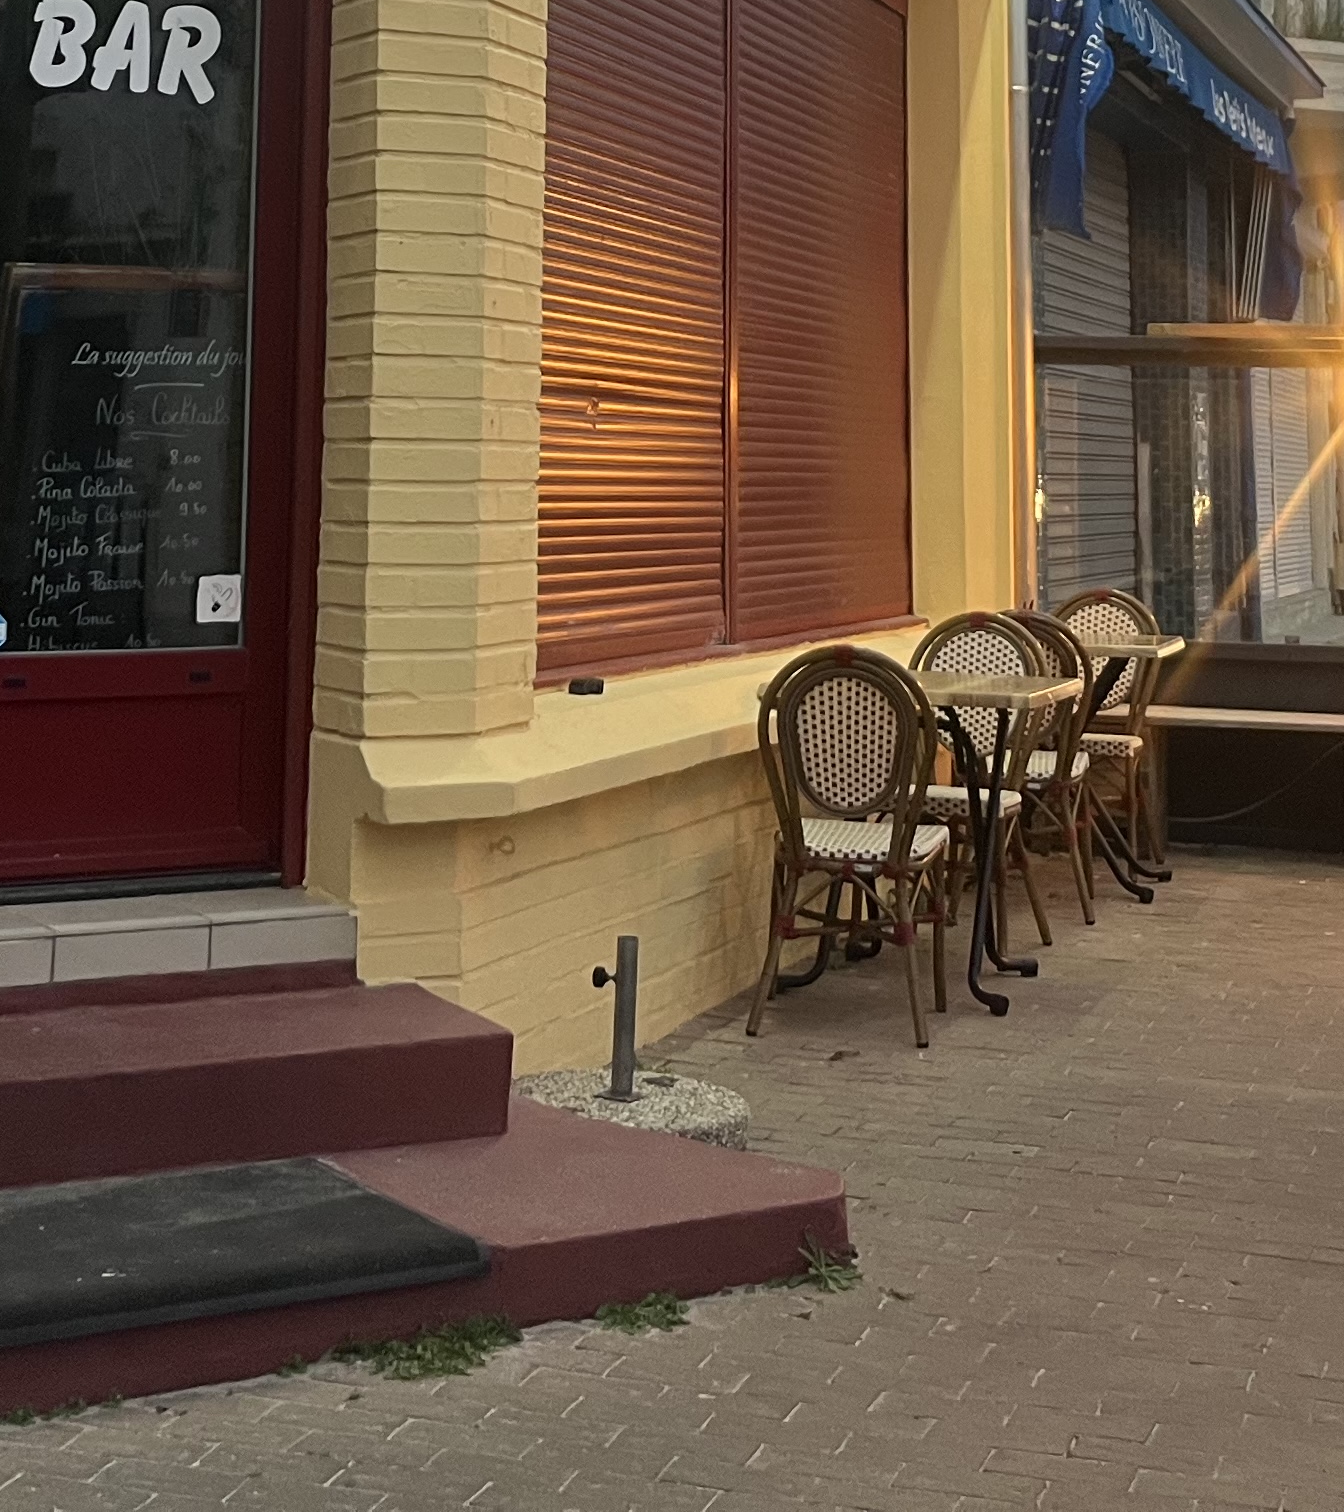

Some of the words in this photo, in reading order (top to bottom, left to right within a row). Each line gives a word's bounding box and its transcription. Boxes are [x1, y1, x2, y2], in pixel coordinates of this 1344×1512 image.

[71, 342, 99, 366] La
[102, 343, 193, 378] suggestion
[196, 339, 219, 366] du
[209, 350, 246, 378] jou
[96, 393, 136, 425] Nos
[42, 450, 81, 473] Cuba
[80, 475, 137, 499] Colada
[33, 535, 89, 568] Mojito
[30, 571, 81, 605] Mojito
[87, 570, 144, 592] Passion
[27, 607, 62, 628] Gin
